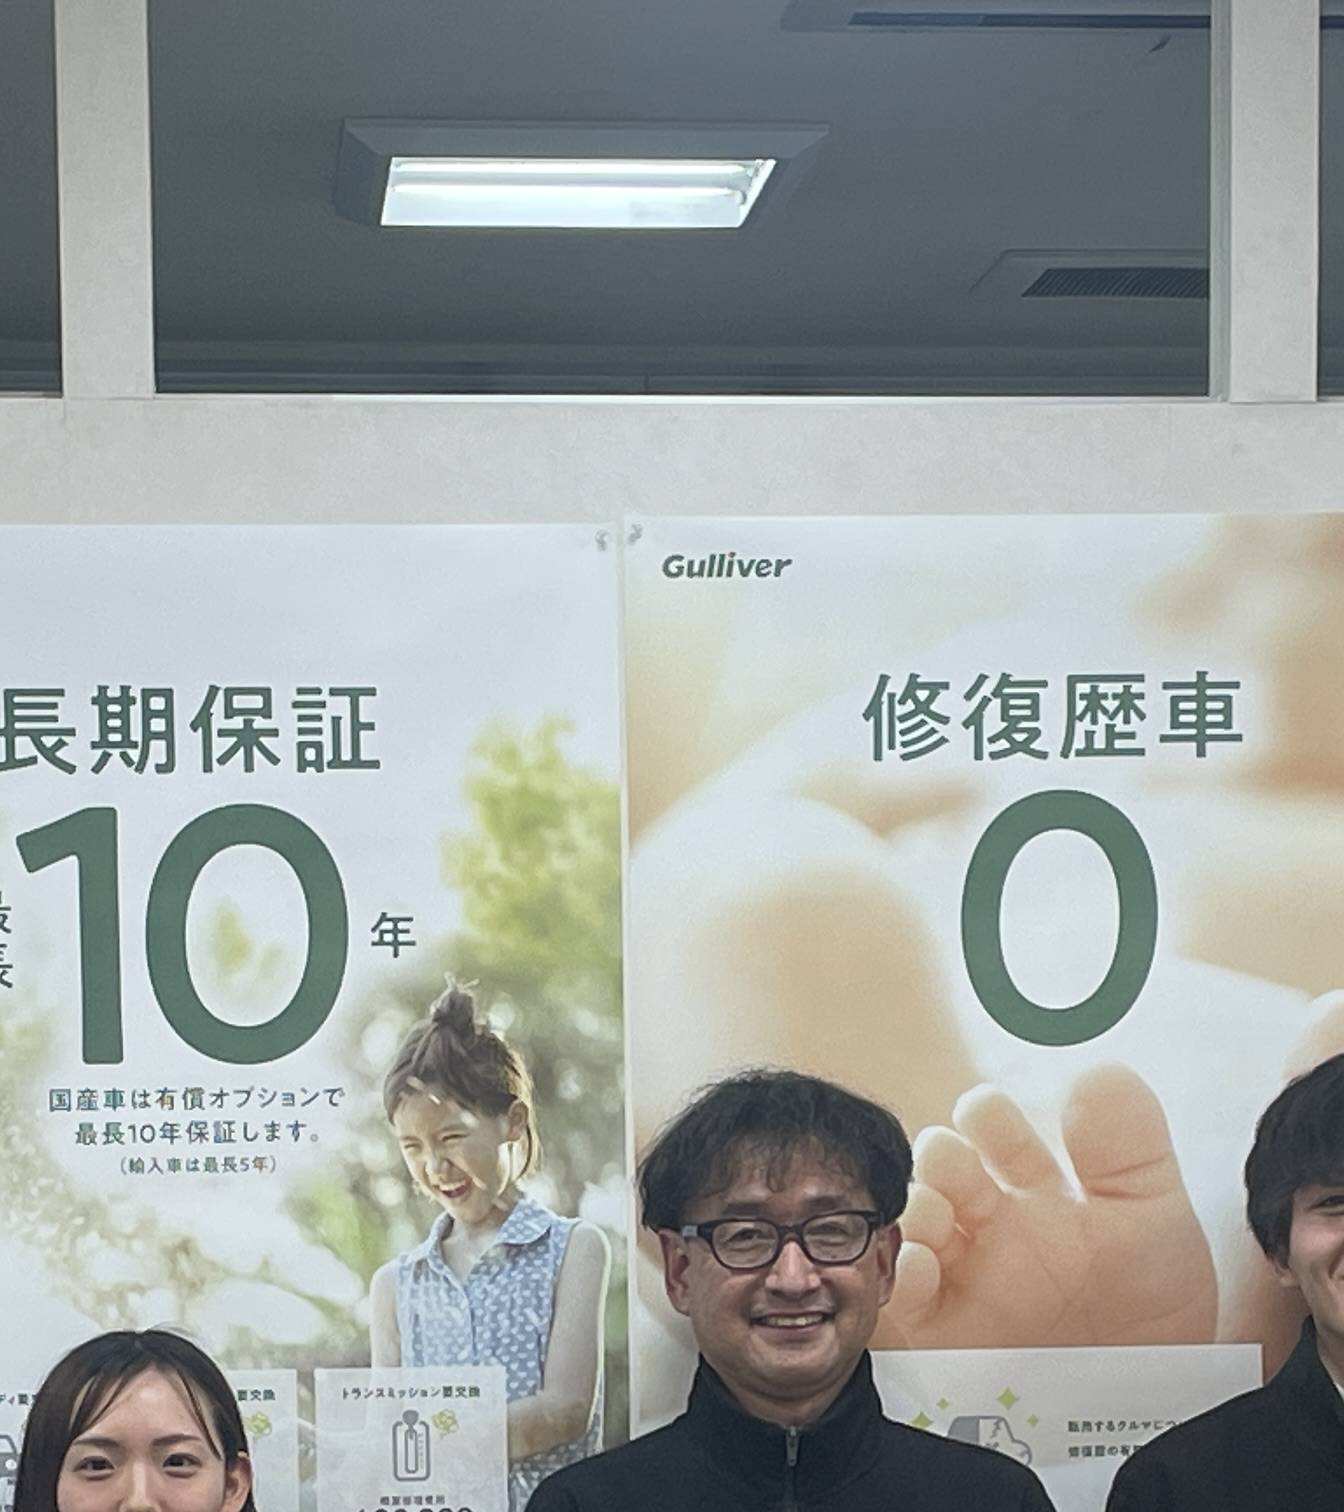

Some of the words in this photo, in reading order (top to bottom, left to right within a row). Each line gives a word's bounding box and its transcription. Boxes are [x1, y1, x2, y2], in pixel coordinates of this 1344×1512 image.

[660, 550, 794, 580] Gulliver
[862, 670, 1245, 763] 修復歴車
[15, 803, 349, 1066] 10
[370, 911, 418, 959] 年
[959, 788, 1159, 1048] 0
[47, 1085, 346, 1114] 国産車は有償オプションで
[73, 1119, 322, 1146] 最長10年保証します。
